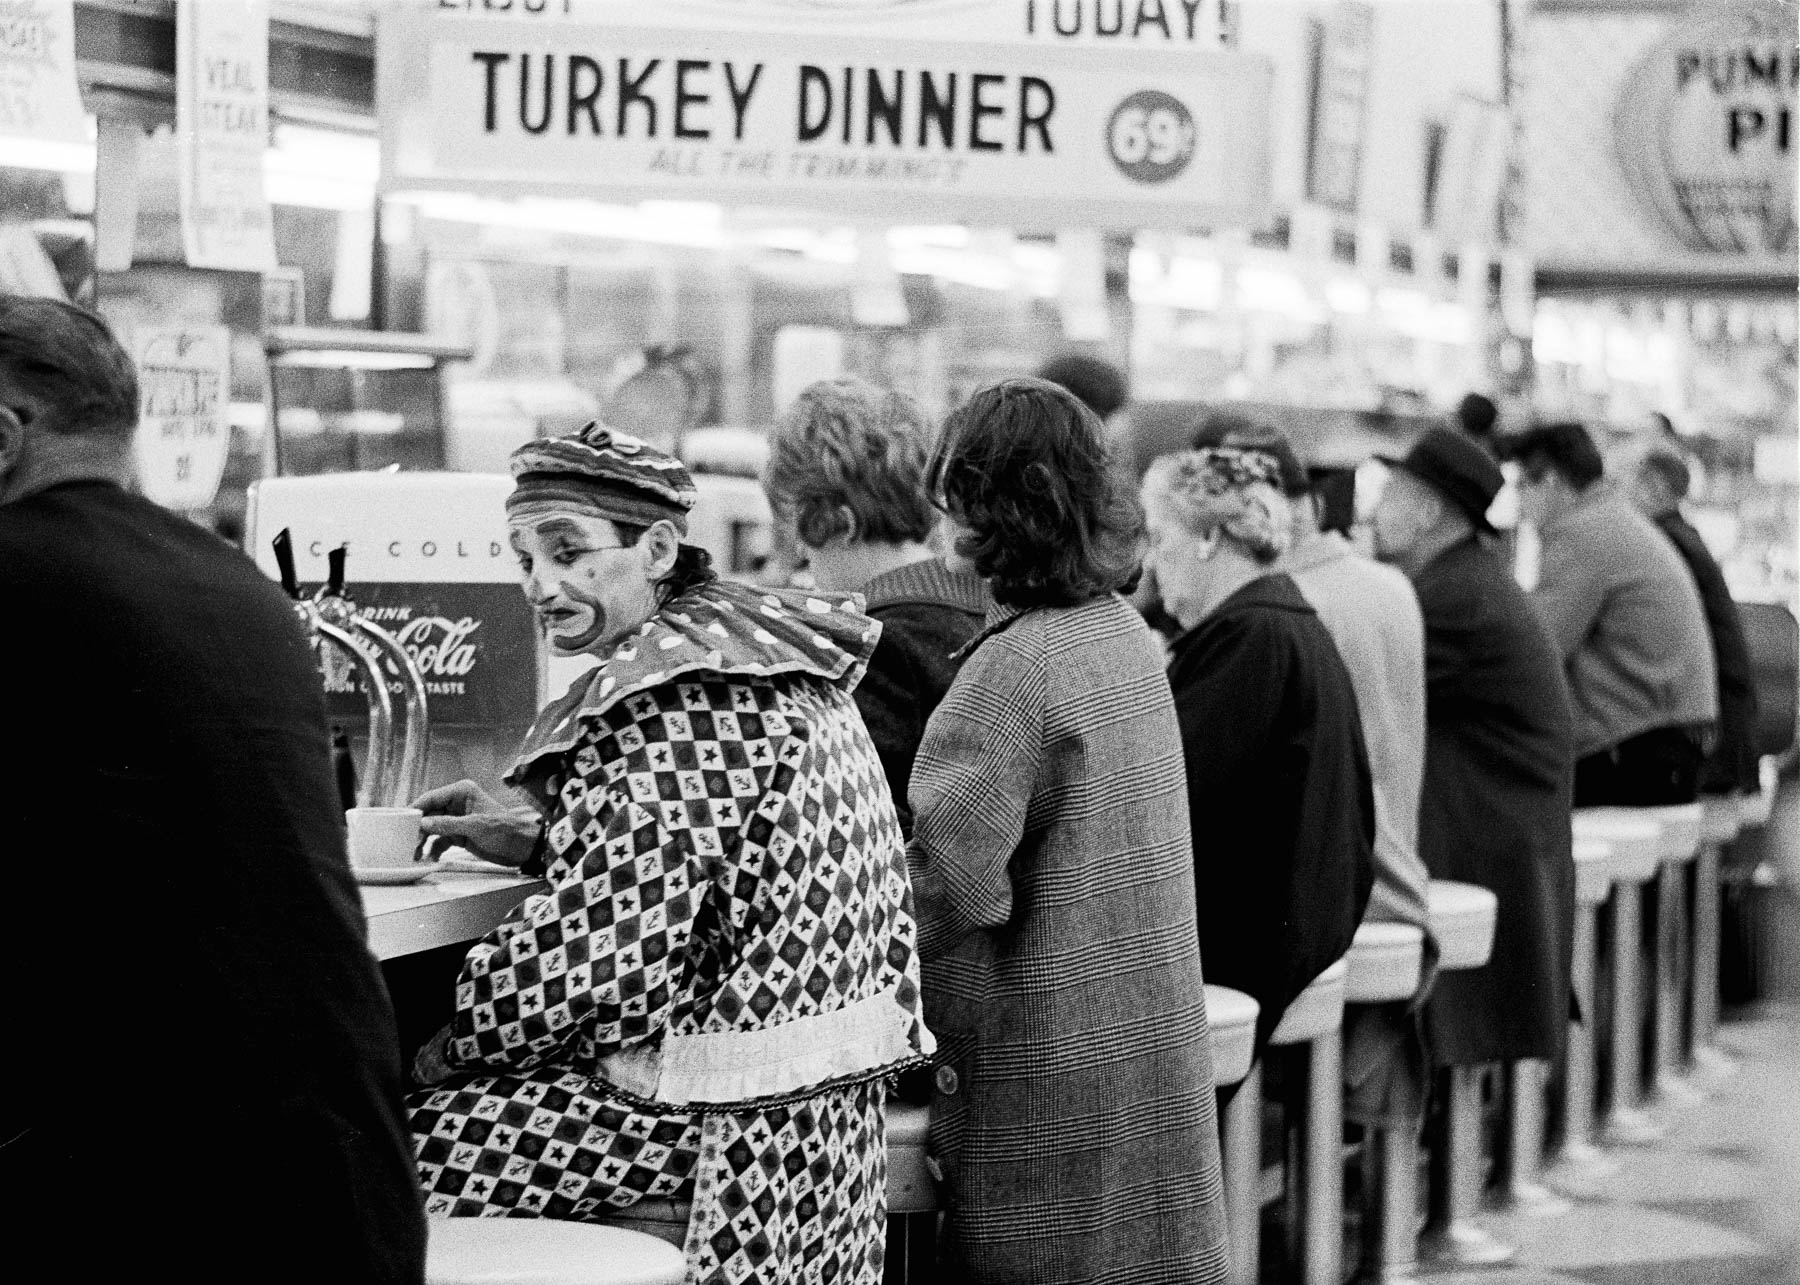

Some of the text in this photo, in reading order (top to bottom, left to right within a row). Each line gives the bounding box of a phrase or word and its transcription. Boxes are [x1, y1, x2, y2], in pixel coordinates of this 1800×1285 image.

[471, 51, 1058, 154] TURKEY DINNER
[648, 149, 703, 176] ALL
[718, 150, 774, 178] THE
[309, 540, 502, 558] CE COLD
[358, 606, 413, 620] RINK
[426, 682, 466, 695] TASTE
